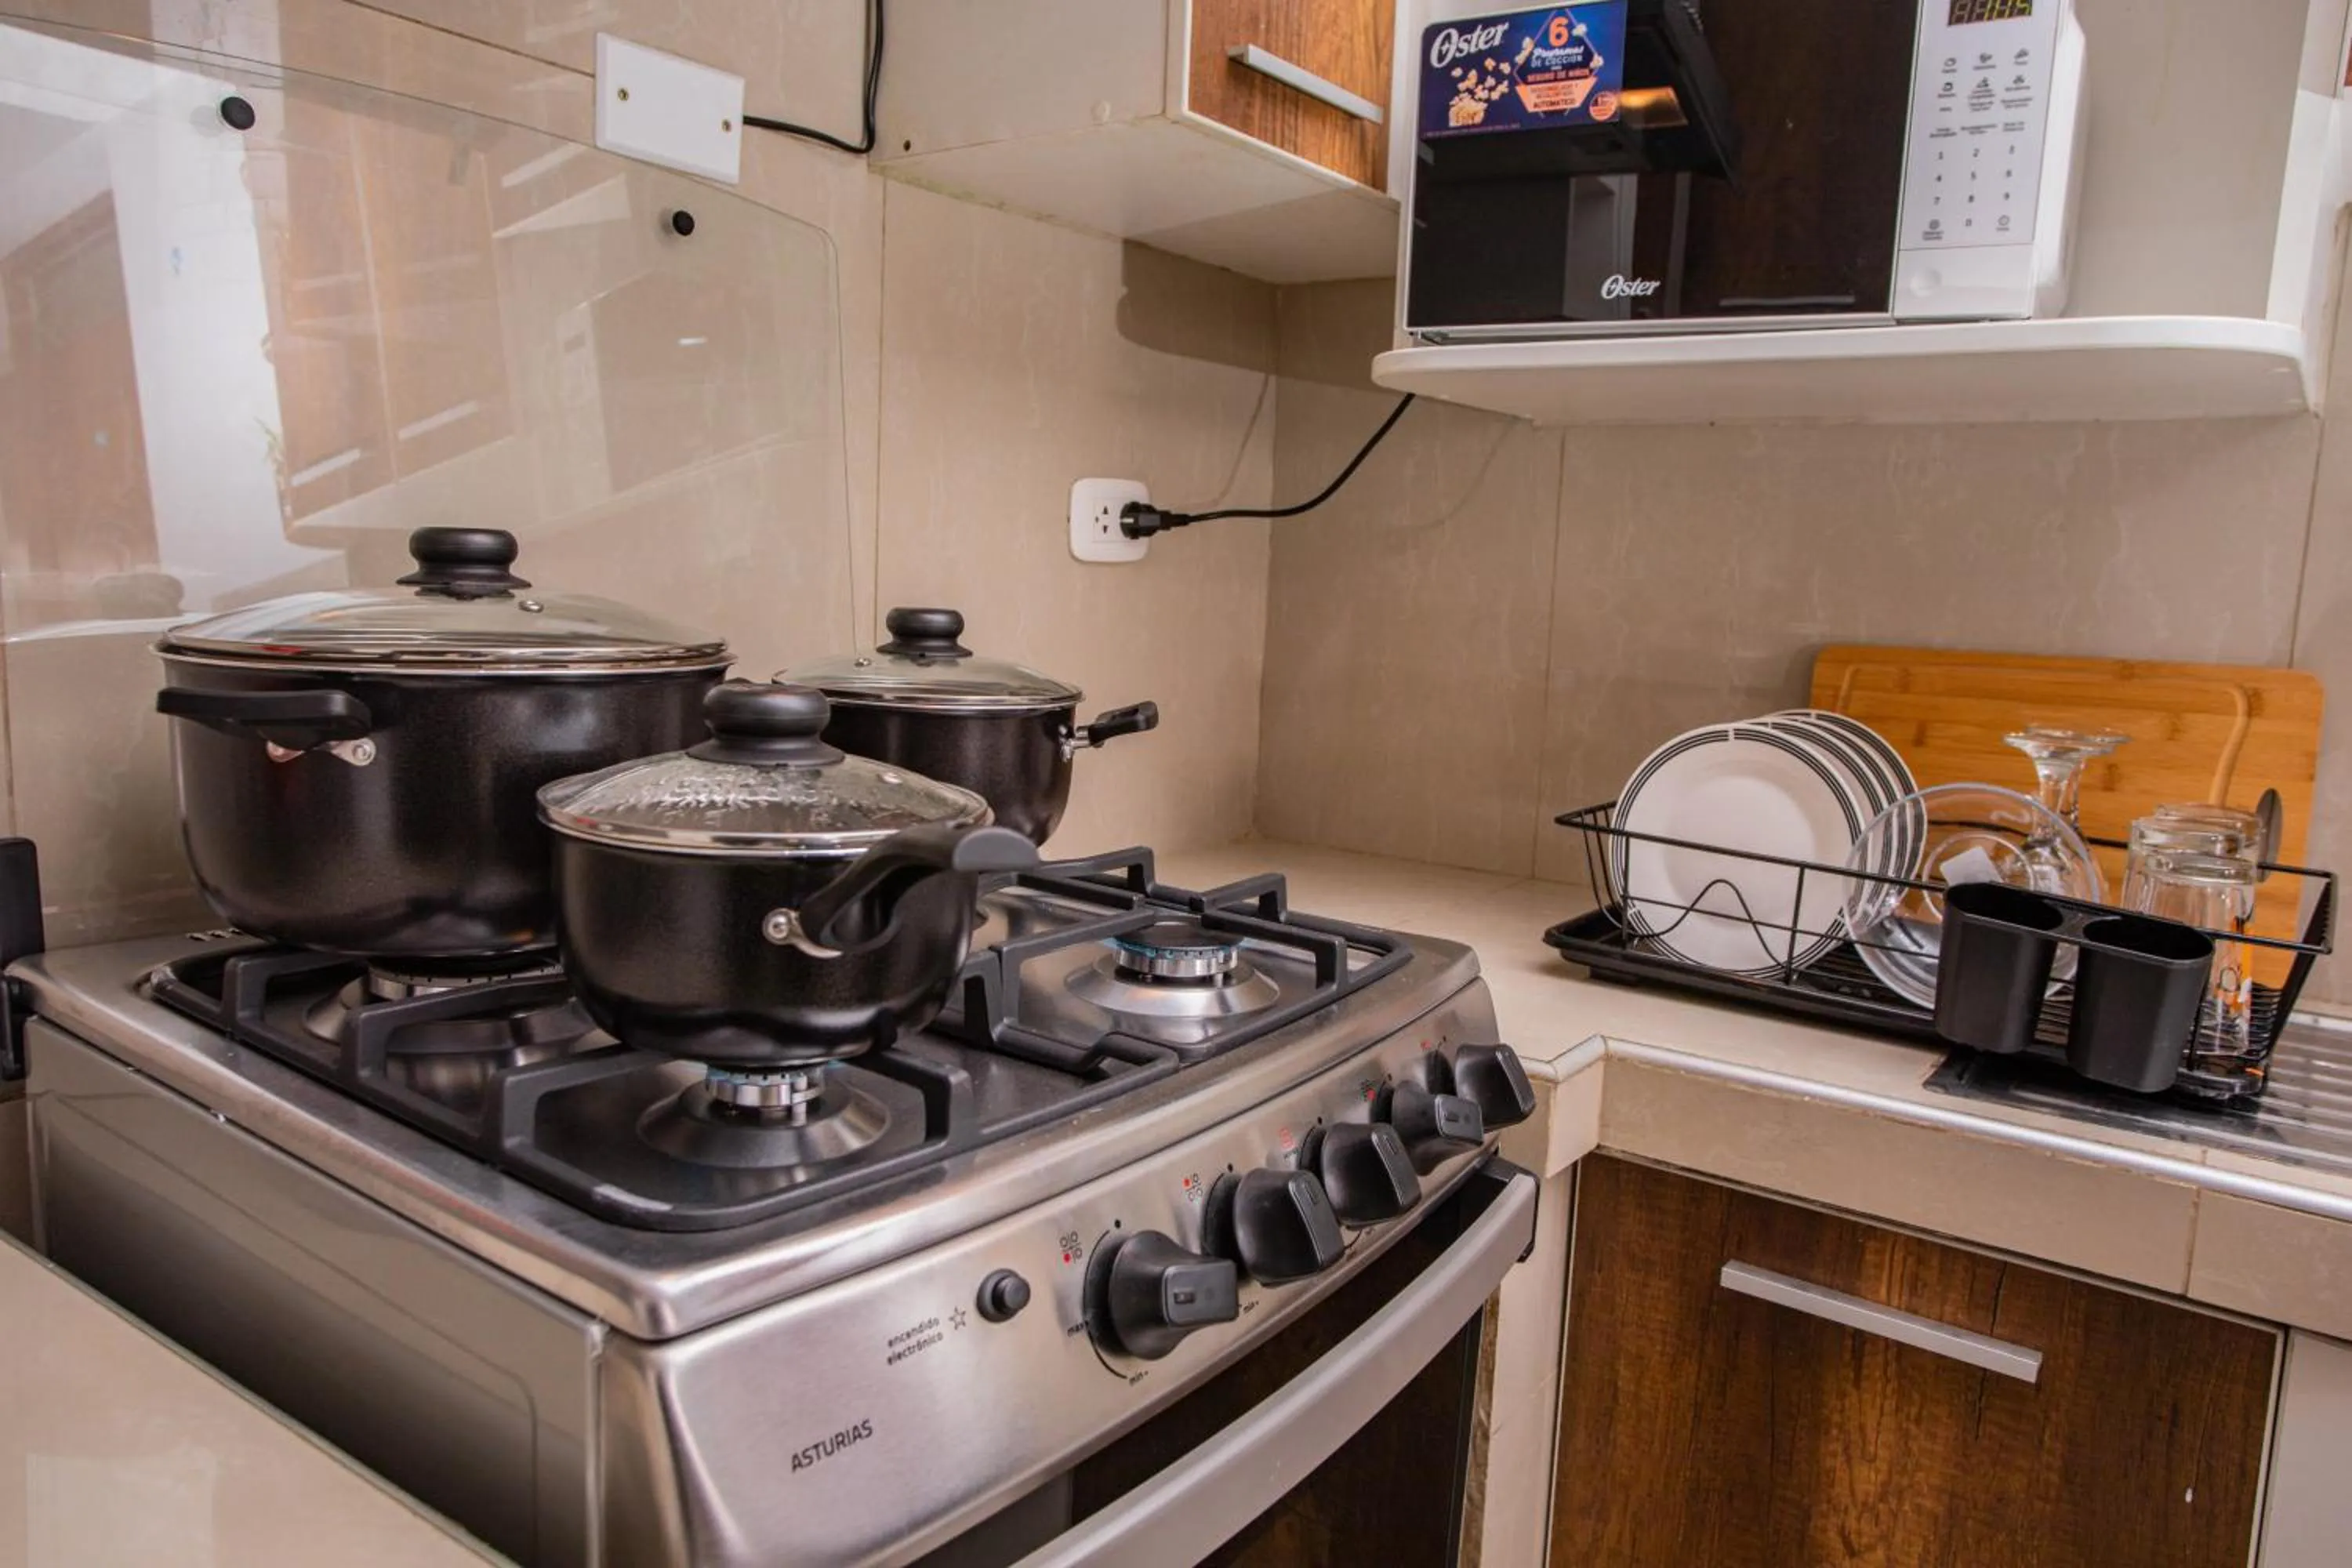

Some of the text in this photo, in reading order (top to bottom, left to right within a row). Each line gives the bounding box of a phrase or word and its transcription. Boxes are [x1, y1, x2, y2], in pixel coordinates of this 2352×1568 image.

[1429, 22, 1510, 68] Oster
[1549, 16, 1570, 47] 6
[1601, 274, 1661, 299] Oster
[887, 1317, 940, 1348] encendido
[887, 1332, 943, 1366] electrónico
[790, 1417, 874, 1474] ASTURIAS
